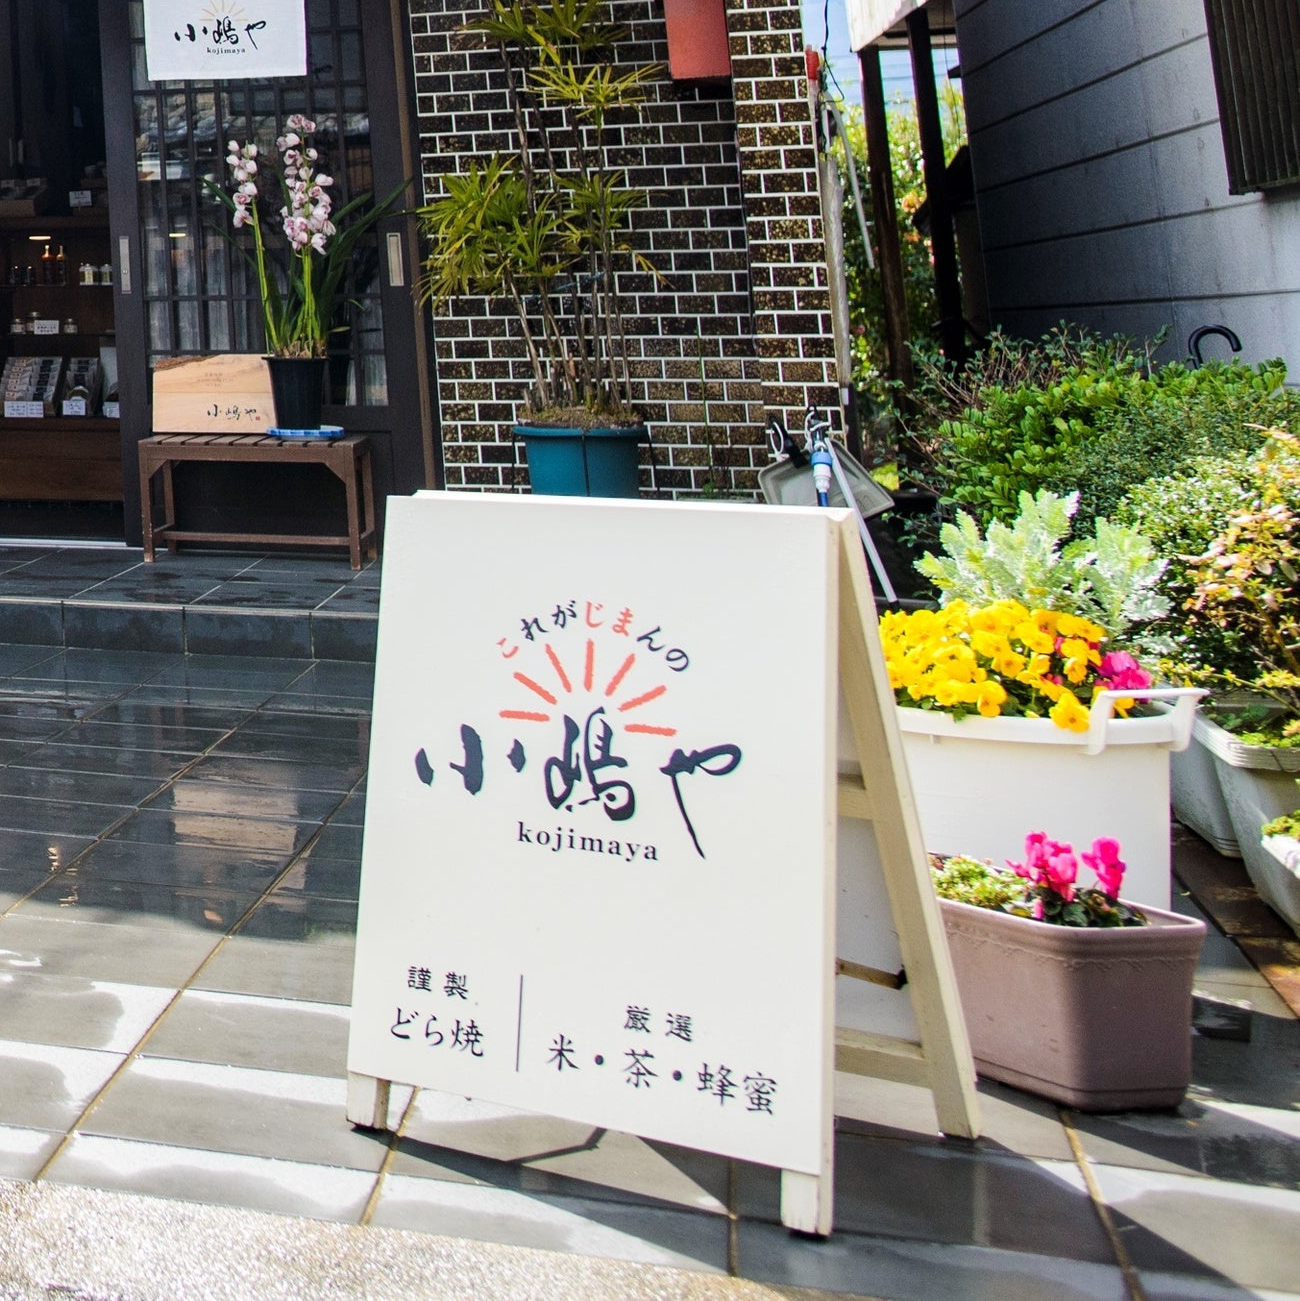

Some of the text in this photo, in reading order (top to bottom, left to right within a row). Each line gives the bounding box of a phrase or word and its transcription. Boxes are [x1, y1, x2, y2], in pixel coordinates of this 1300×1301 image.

[206, 47, 246, 55] kojimaya
[496, 599, 690, 672] これがじまんの
[414, 706, 742, 860] 小嶋や
[518, 821, 659, 861] kojimaya
[407, 966, 469, 1000] 謹製
[390, 1007, 484, 1058] どら焼
[624, 1005, 693, 1043] 厳選
